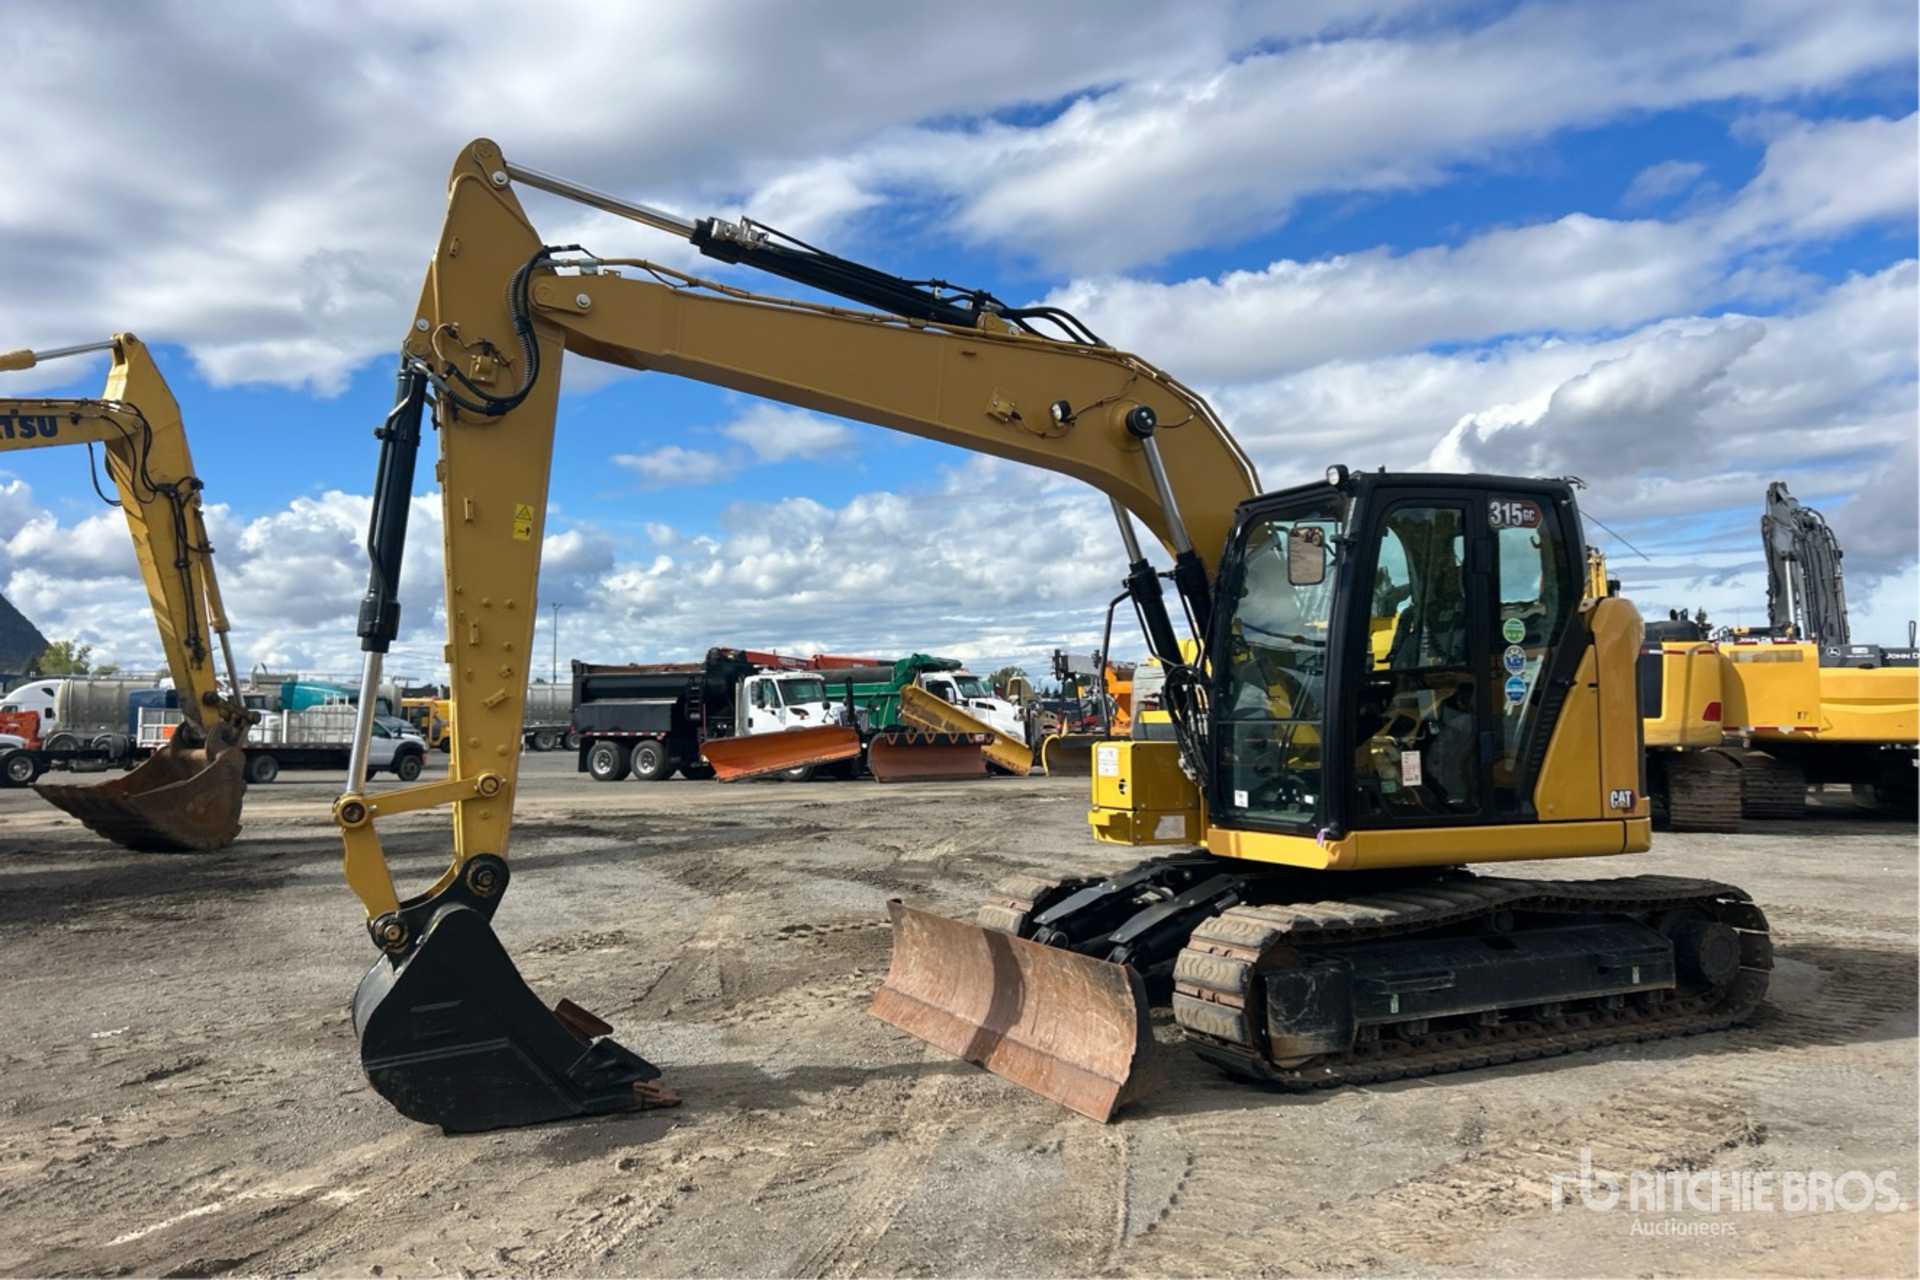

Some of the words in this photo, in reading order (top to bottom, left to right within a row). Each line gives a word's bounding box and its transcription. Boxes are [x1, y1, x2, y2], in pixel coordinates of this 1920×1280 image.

[0, 415, 59, 439] TSU
[1490, 502, 1522, 526] 315
[1885, 652, 1910, 660] JOHN
[1610, 790, 1632, 809] CAT
